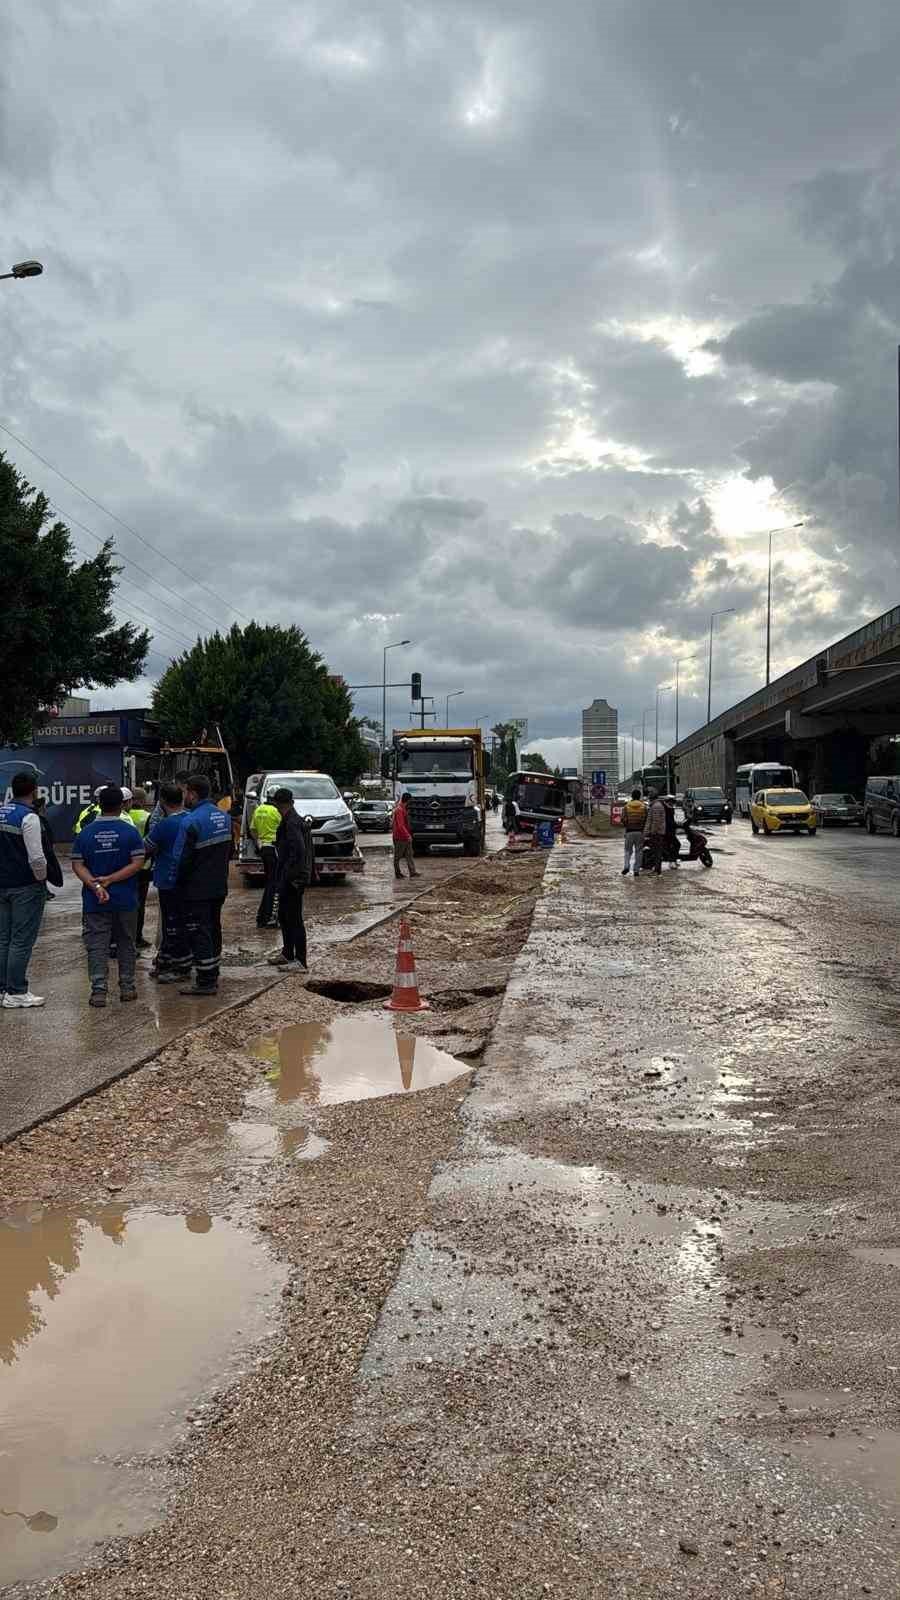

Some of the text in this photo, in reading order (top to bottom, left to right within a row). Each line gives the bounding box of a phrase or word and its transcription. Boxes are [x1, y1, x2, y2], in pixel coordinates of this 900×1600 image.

[38, 723, 116, 736] DOSTLAR BÜFE
[37, 781, 91, 805] BÜFE
